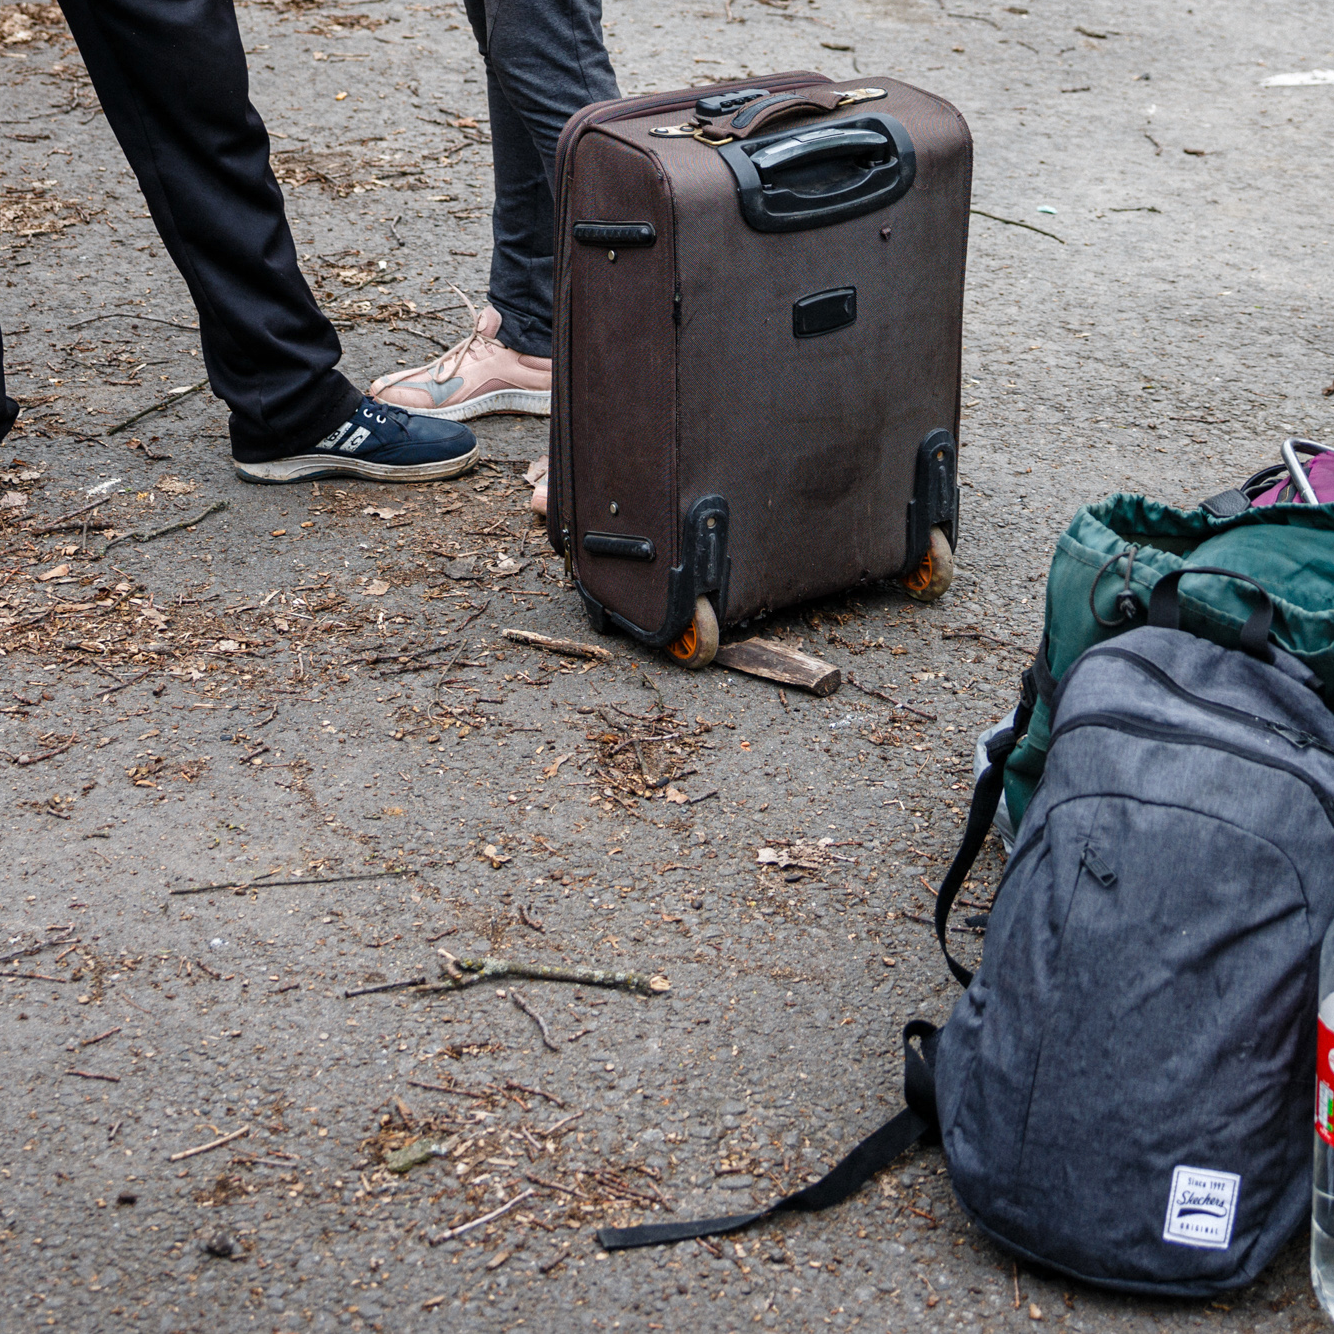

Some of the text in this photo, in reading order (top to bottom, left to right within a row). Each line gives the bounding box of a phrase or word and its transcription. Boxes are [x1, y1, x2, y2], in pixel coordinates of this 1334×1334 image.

[1188, 1177, 1226, 1191] Since 1992
[1176, 1190, 1225, 1207] Skechers
[1180, 1222, 1219, 1235] ORIGINAL
